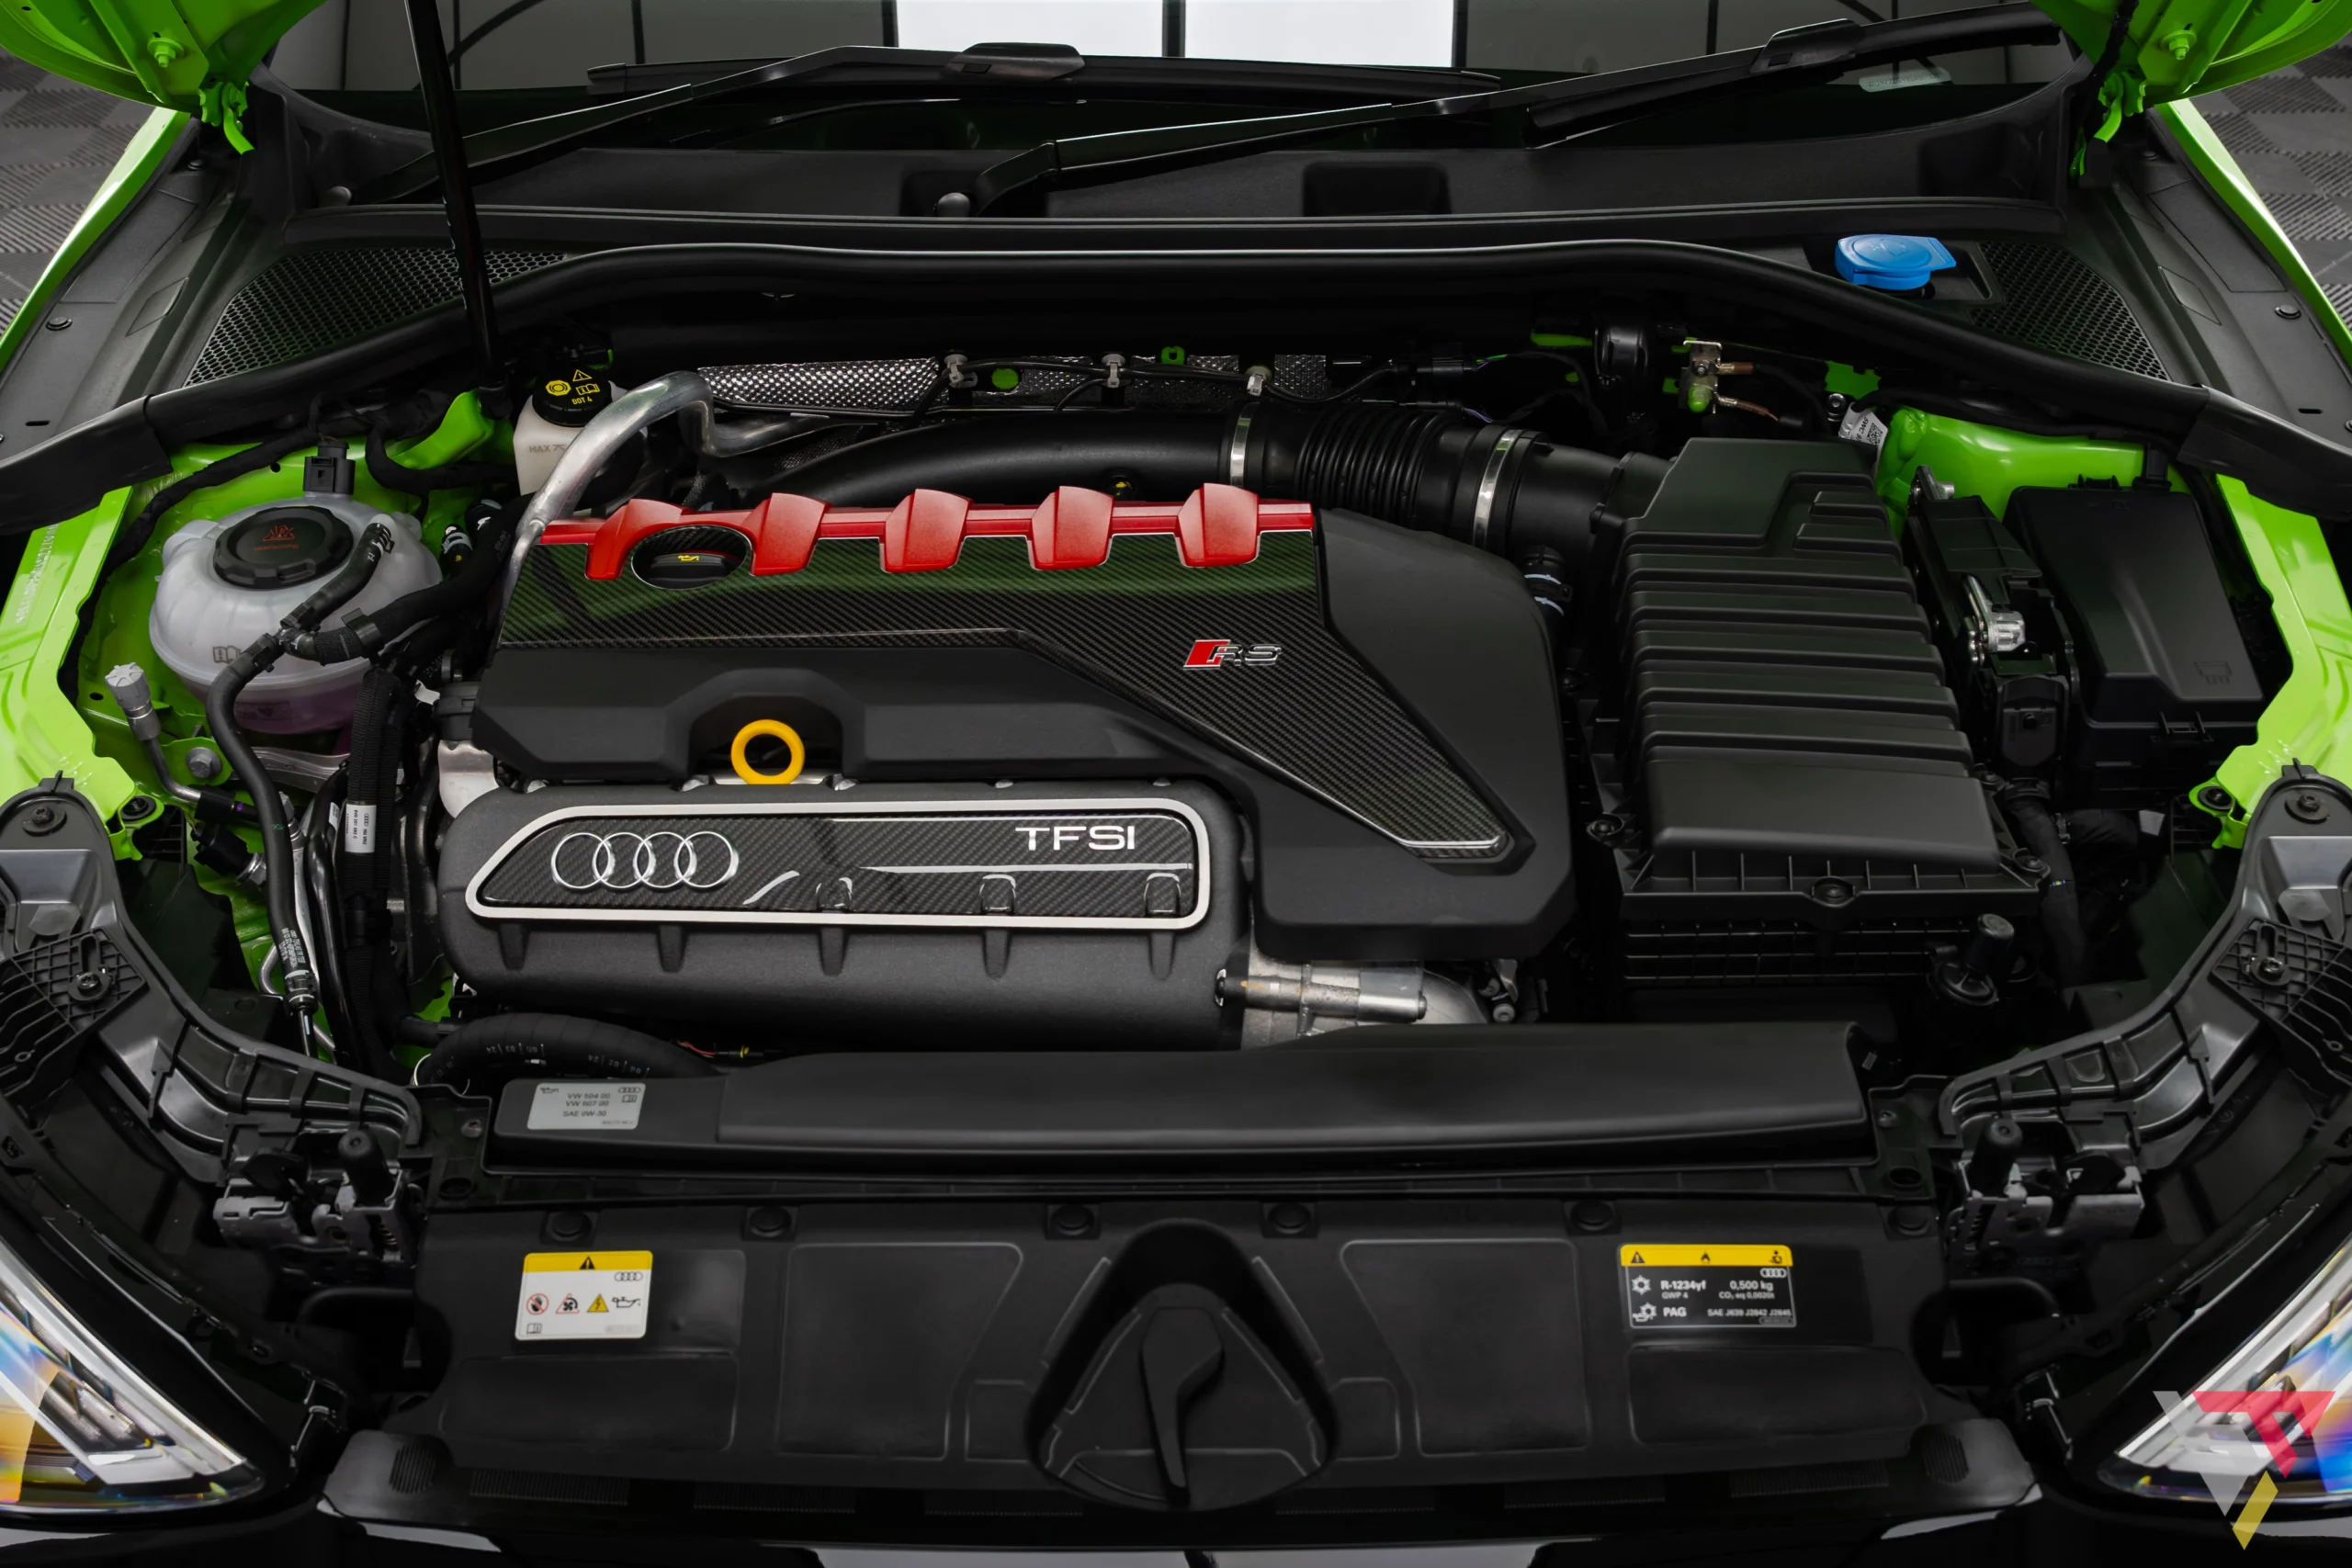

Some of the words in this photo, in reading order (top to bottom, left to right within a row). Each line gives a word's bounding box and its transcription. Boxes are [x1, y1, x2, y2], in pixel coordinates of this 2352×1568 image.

[1859, 416, 1869, 434] SWC
[529, 445, 550, 453] MAX
[1196, 640, 1282, 668] RS
[1015, 825, 1136, 851] TFSI
[1660, 1280, 1706, 1292] R-1234yf
[1730, 1280, 1758, 1291] 0,500
[1760, 1280, 1774, 1292] kg
[1663, 1307, 1687, 1317] PAG
